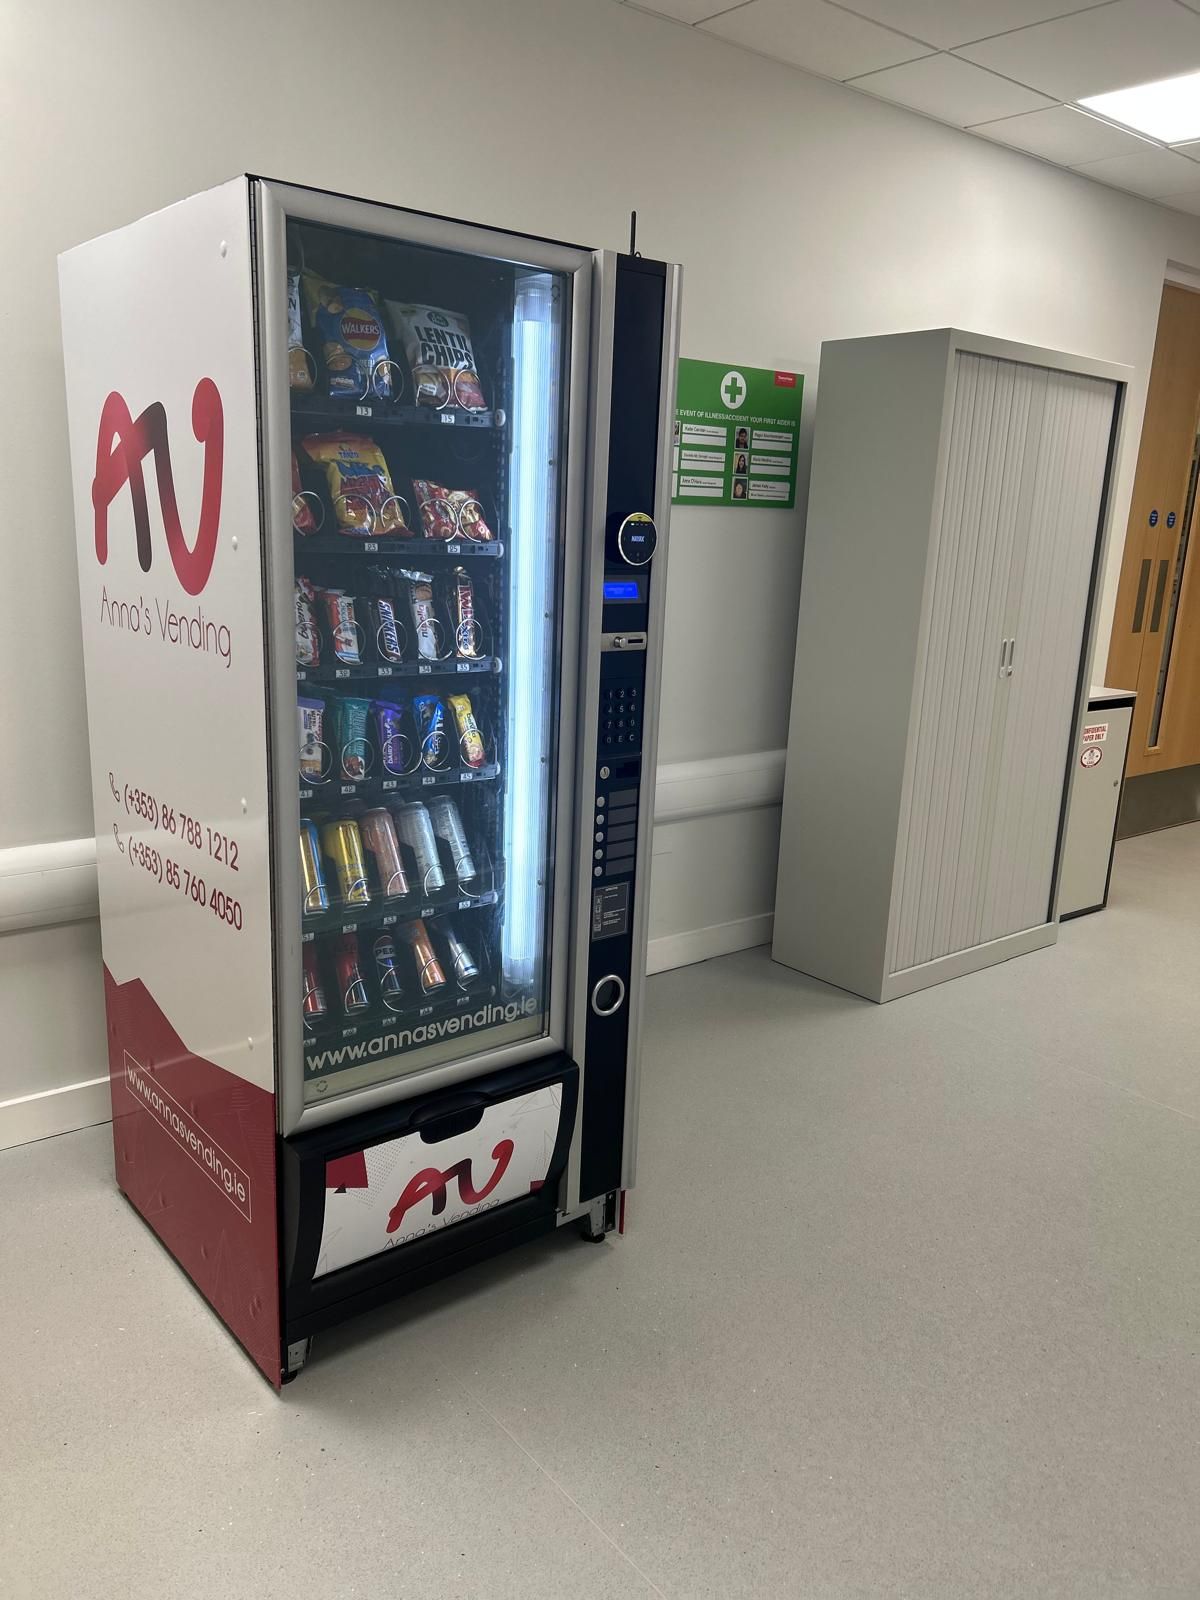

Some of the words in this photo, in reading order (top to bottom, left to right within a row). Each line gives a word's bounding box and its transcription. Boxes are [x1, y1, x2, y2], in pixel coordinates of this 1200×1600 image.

[342, 322, 380, 335] WALKERS
[421, 342, 475, 370] CHIPS
[679, 409, 696, 417] EVENT
[750, 416, 763, 424] YOUR
[101, 585, 152, 636] Anna's
[155, 597, 232, 668] Vending
[378, 600, 400, 654] SNICKERS
[124, 784, 158, 830] (+353)
[162, 804, 177, 835] 86
[179, 813, 203, 850] 788
[206, 827, 239, 871] 1212
[128, 836, 163, 883] (+353)
[166, 859, 181, 889] 85
[184, 869, 206, 906] 760
[209, 888, 242, 930] 4050
[306, 997, 538, 1072] www.annasvending.ie
[127, 1066, 246, 1202] www.annasvending.ie
